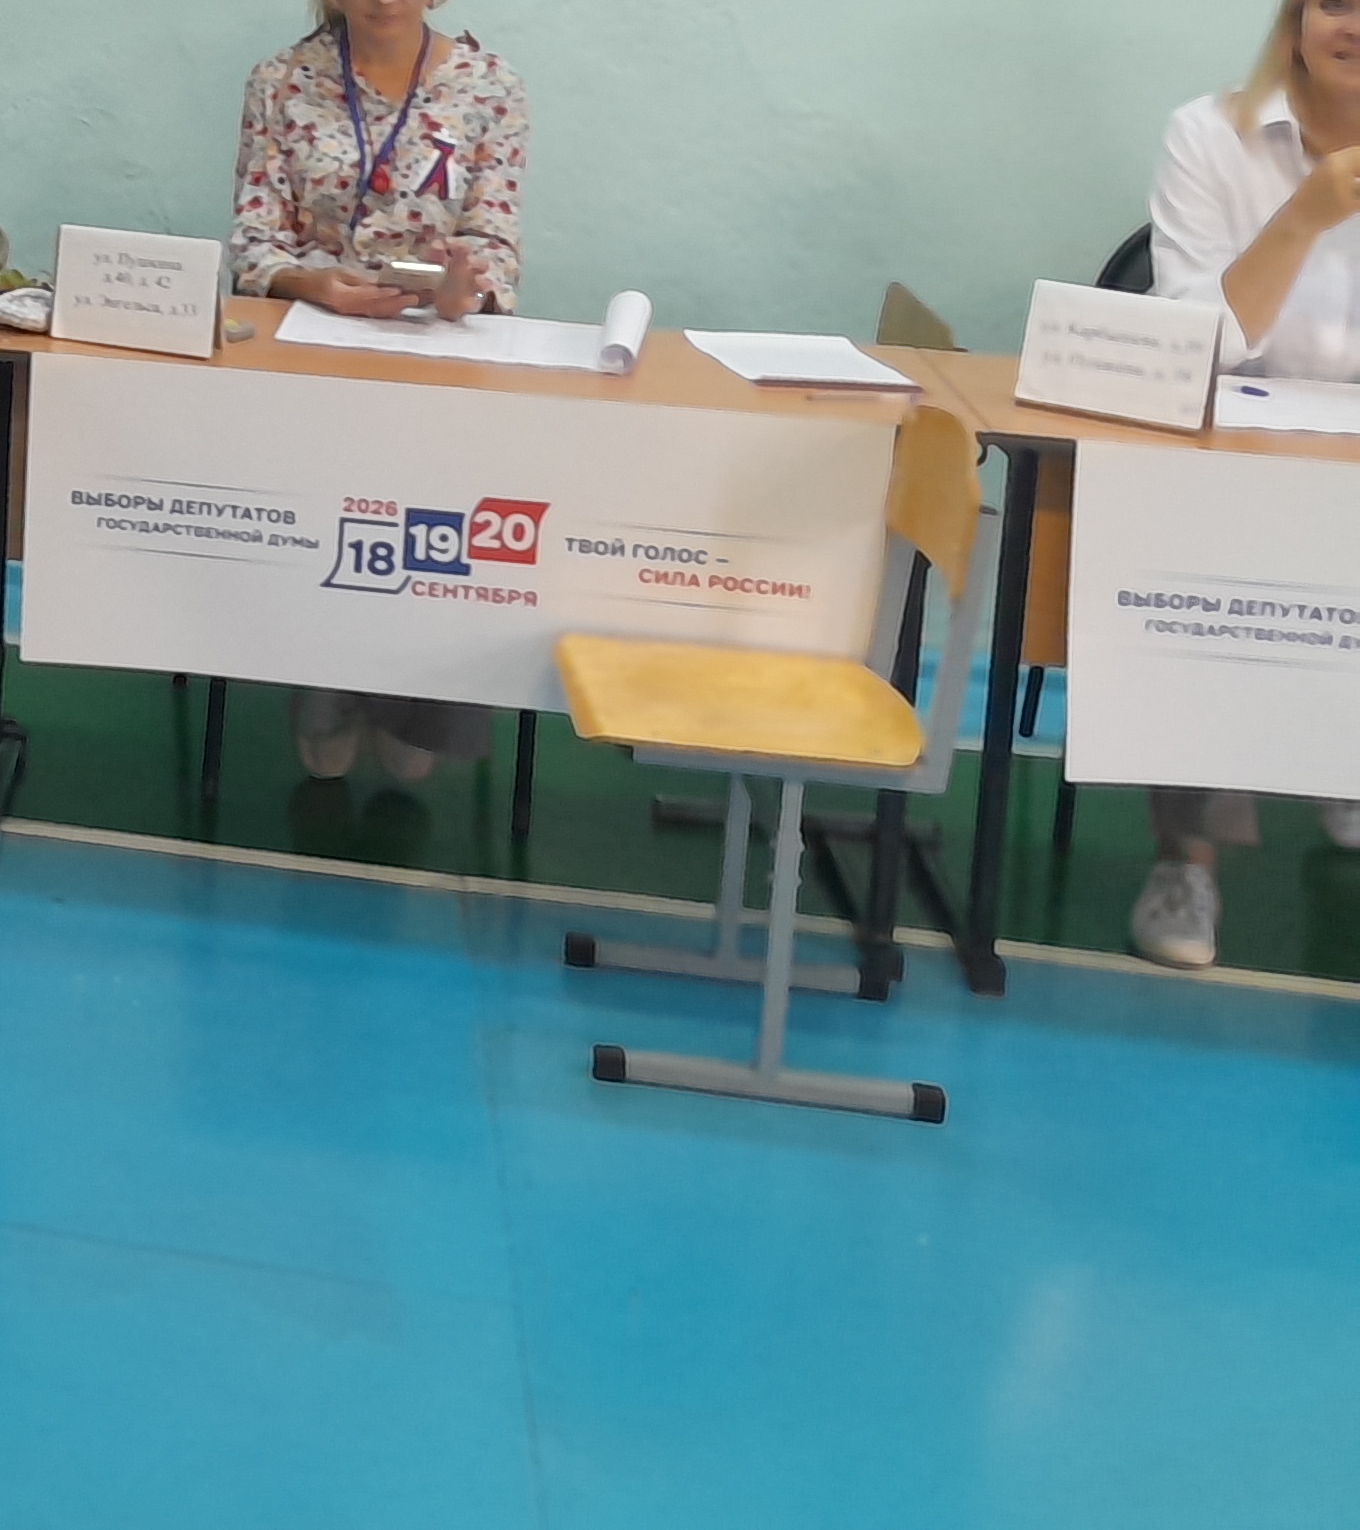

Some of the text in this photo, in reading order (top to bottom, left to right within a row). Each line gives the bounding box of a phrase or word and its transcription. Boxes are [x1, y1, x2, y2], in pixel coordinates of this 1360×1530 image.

[71, 490, 296, 525] ВЫБОРЫ ДЕПУТАТОВ
[342, 496, 398, 516] 2026
[96, 516, 319, 549] ГОСУДАРСТВЕННОЙ ДУМЫ
[348, 510, 537, 576] 18 19 20
[565, 537, 626, 557] ТВОЙ
[632, 544, 709, 565] ГОЛОС
[638, 568, 701, 588] СИЛА
[411, 580, 538, 607] СЕНТЯБРЯ
[1117, 590, 1222, 612] ВЫБОРЫ
